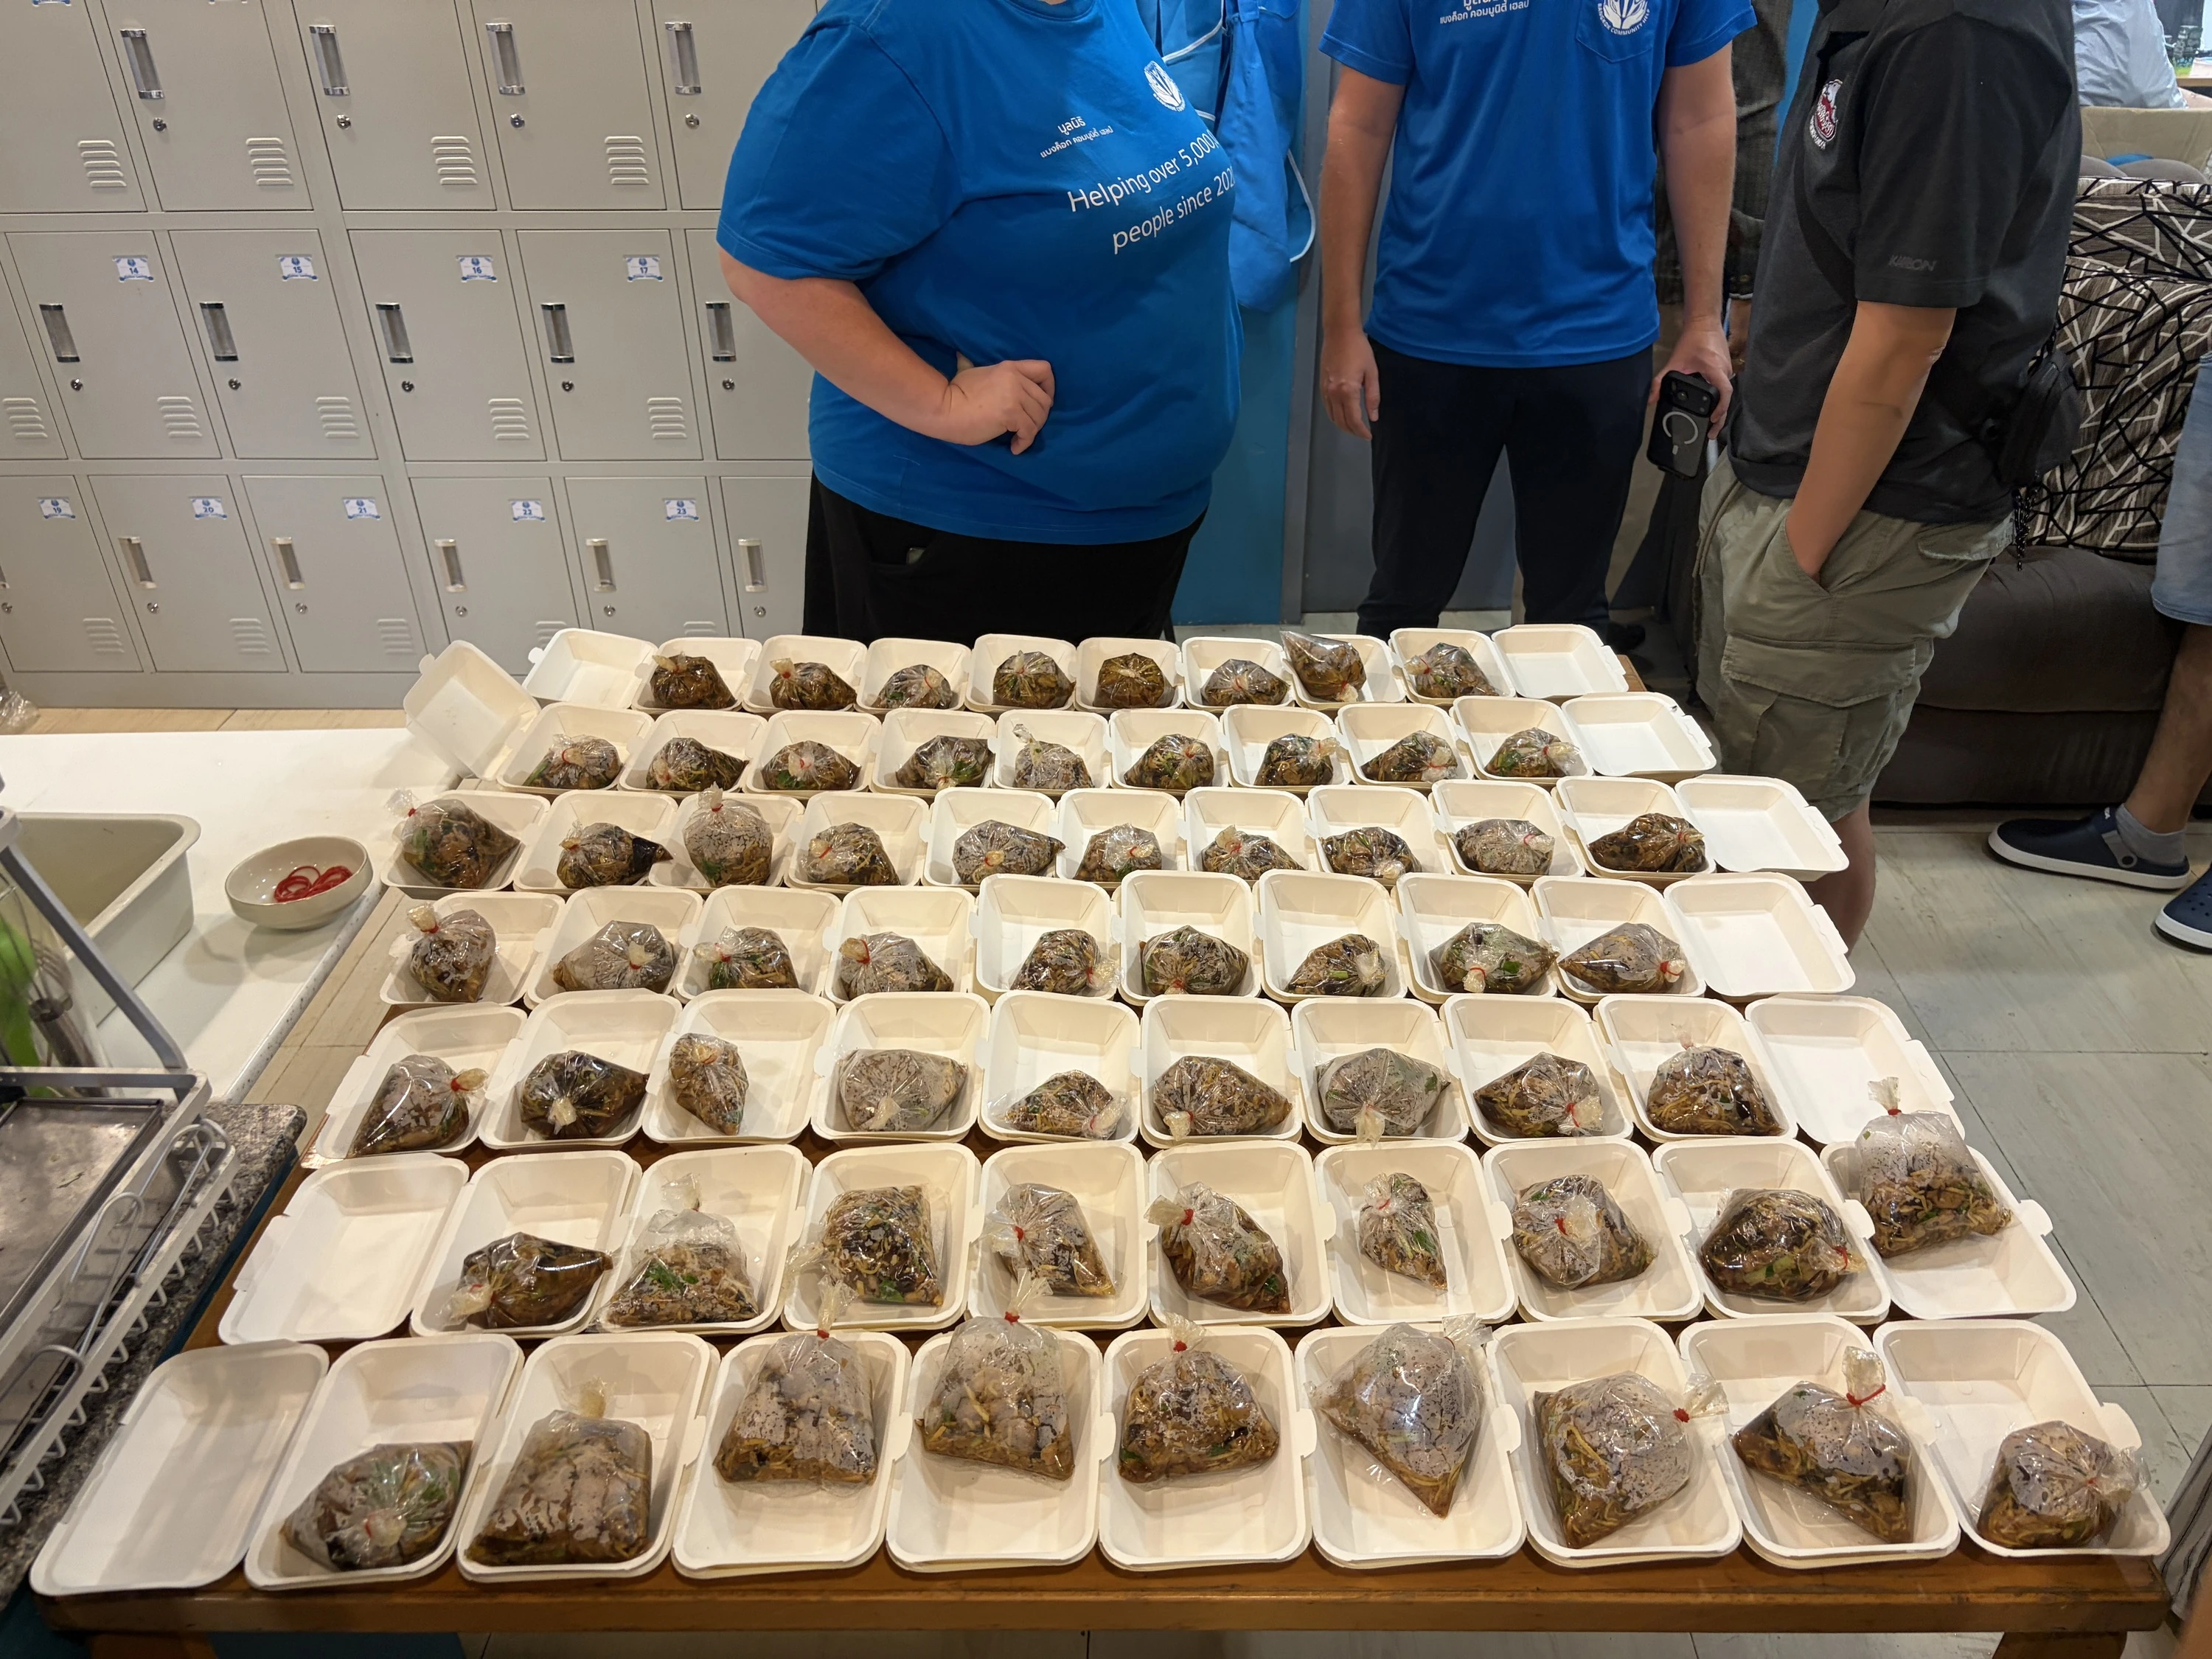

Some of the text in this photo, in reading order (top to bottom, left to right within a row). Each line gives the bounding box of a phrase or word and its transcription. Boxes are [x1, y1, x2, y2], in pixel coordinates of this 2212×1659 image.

[1610, 23, 1643, 35] COMMUNITY
[1067, 173, 1151, 212] Helping
[1149, 157, 1180, 184] over
[1113, 206, 1175, 254] people
[1177, 186, 1212, 219] since
[639, 266, 648, 274] 17
